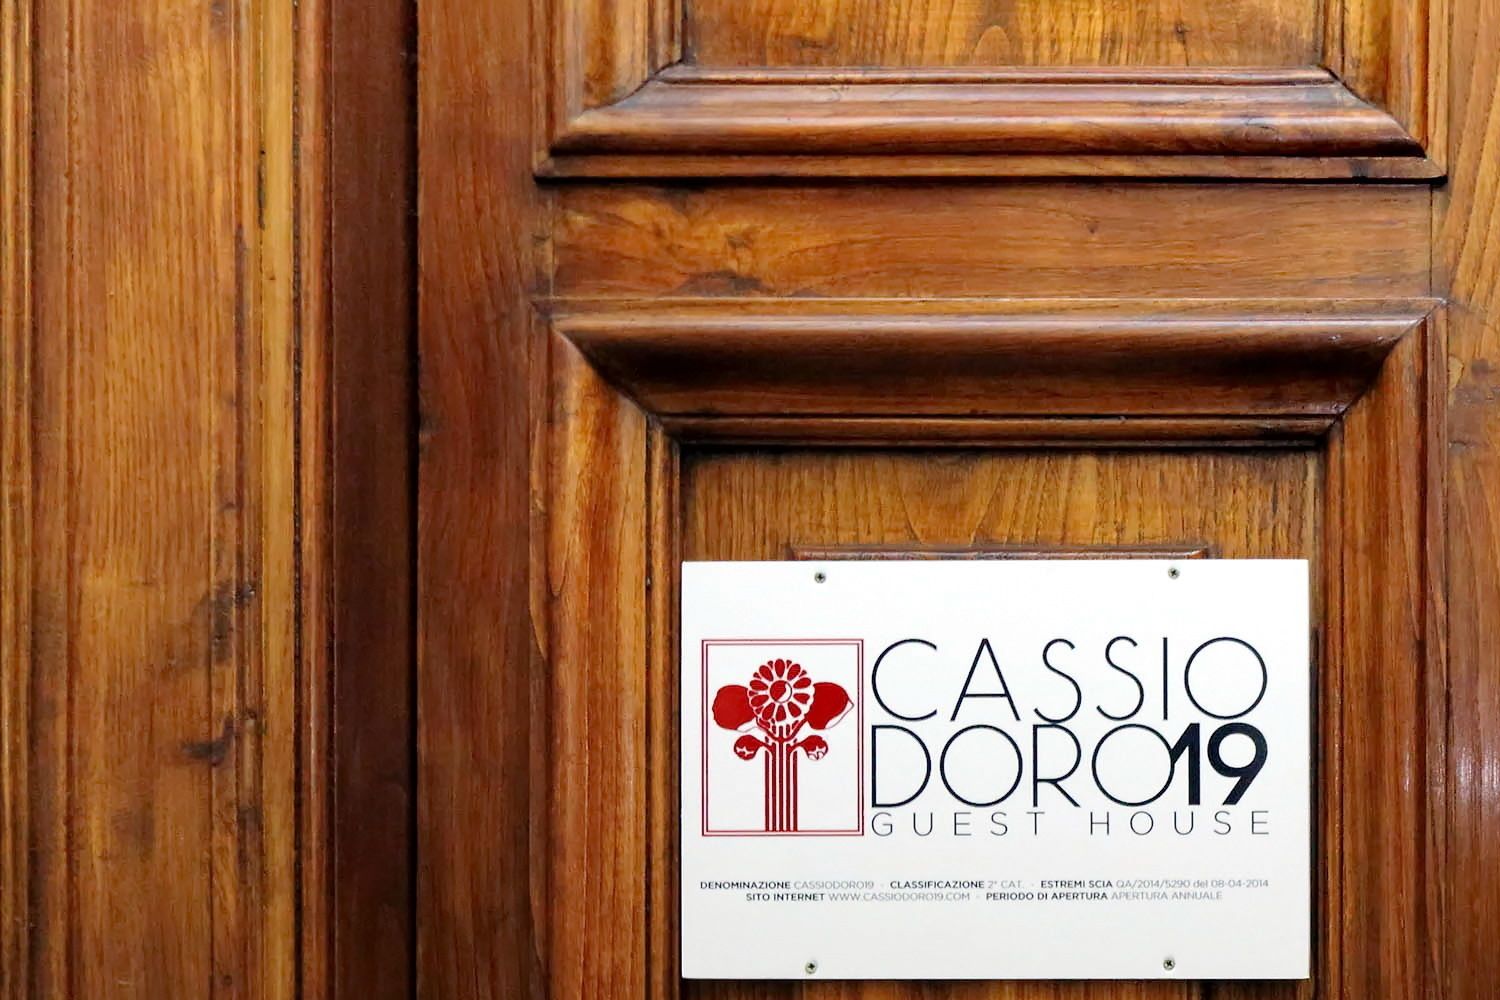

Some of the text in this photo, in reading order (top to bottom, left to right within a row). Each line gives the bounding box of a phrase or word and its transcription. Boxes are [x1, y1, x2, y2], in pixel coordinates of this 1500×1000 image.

[871, 636, 1268, 722] CASSIO
[871, 809, 1270, 837] GUEST HOUSE
[699, 880, 792, 891] DENOMINAZIONE
[793, 880, 875, 890] CASSIODORO19
[889, 880, 986, 891] CLASSIFICAZIONE
[1040, 879, 1086, 890] ESTREMI
[1088, 879, 1114, 890] SCIA
[1192, 879, 1209, 889] del
[1210, 879, 1269, 889] 08-04-2014
[745, 890, 1223, 903] SITO INTERNET WWW.CASSIODORO19.COM PERIODO DI APERTURA APERTURA ANNUALE
